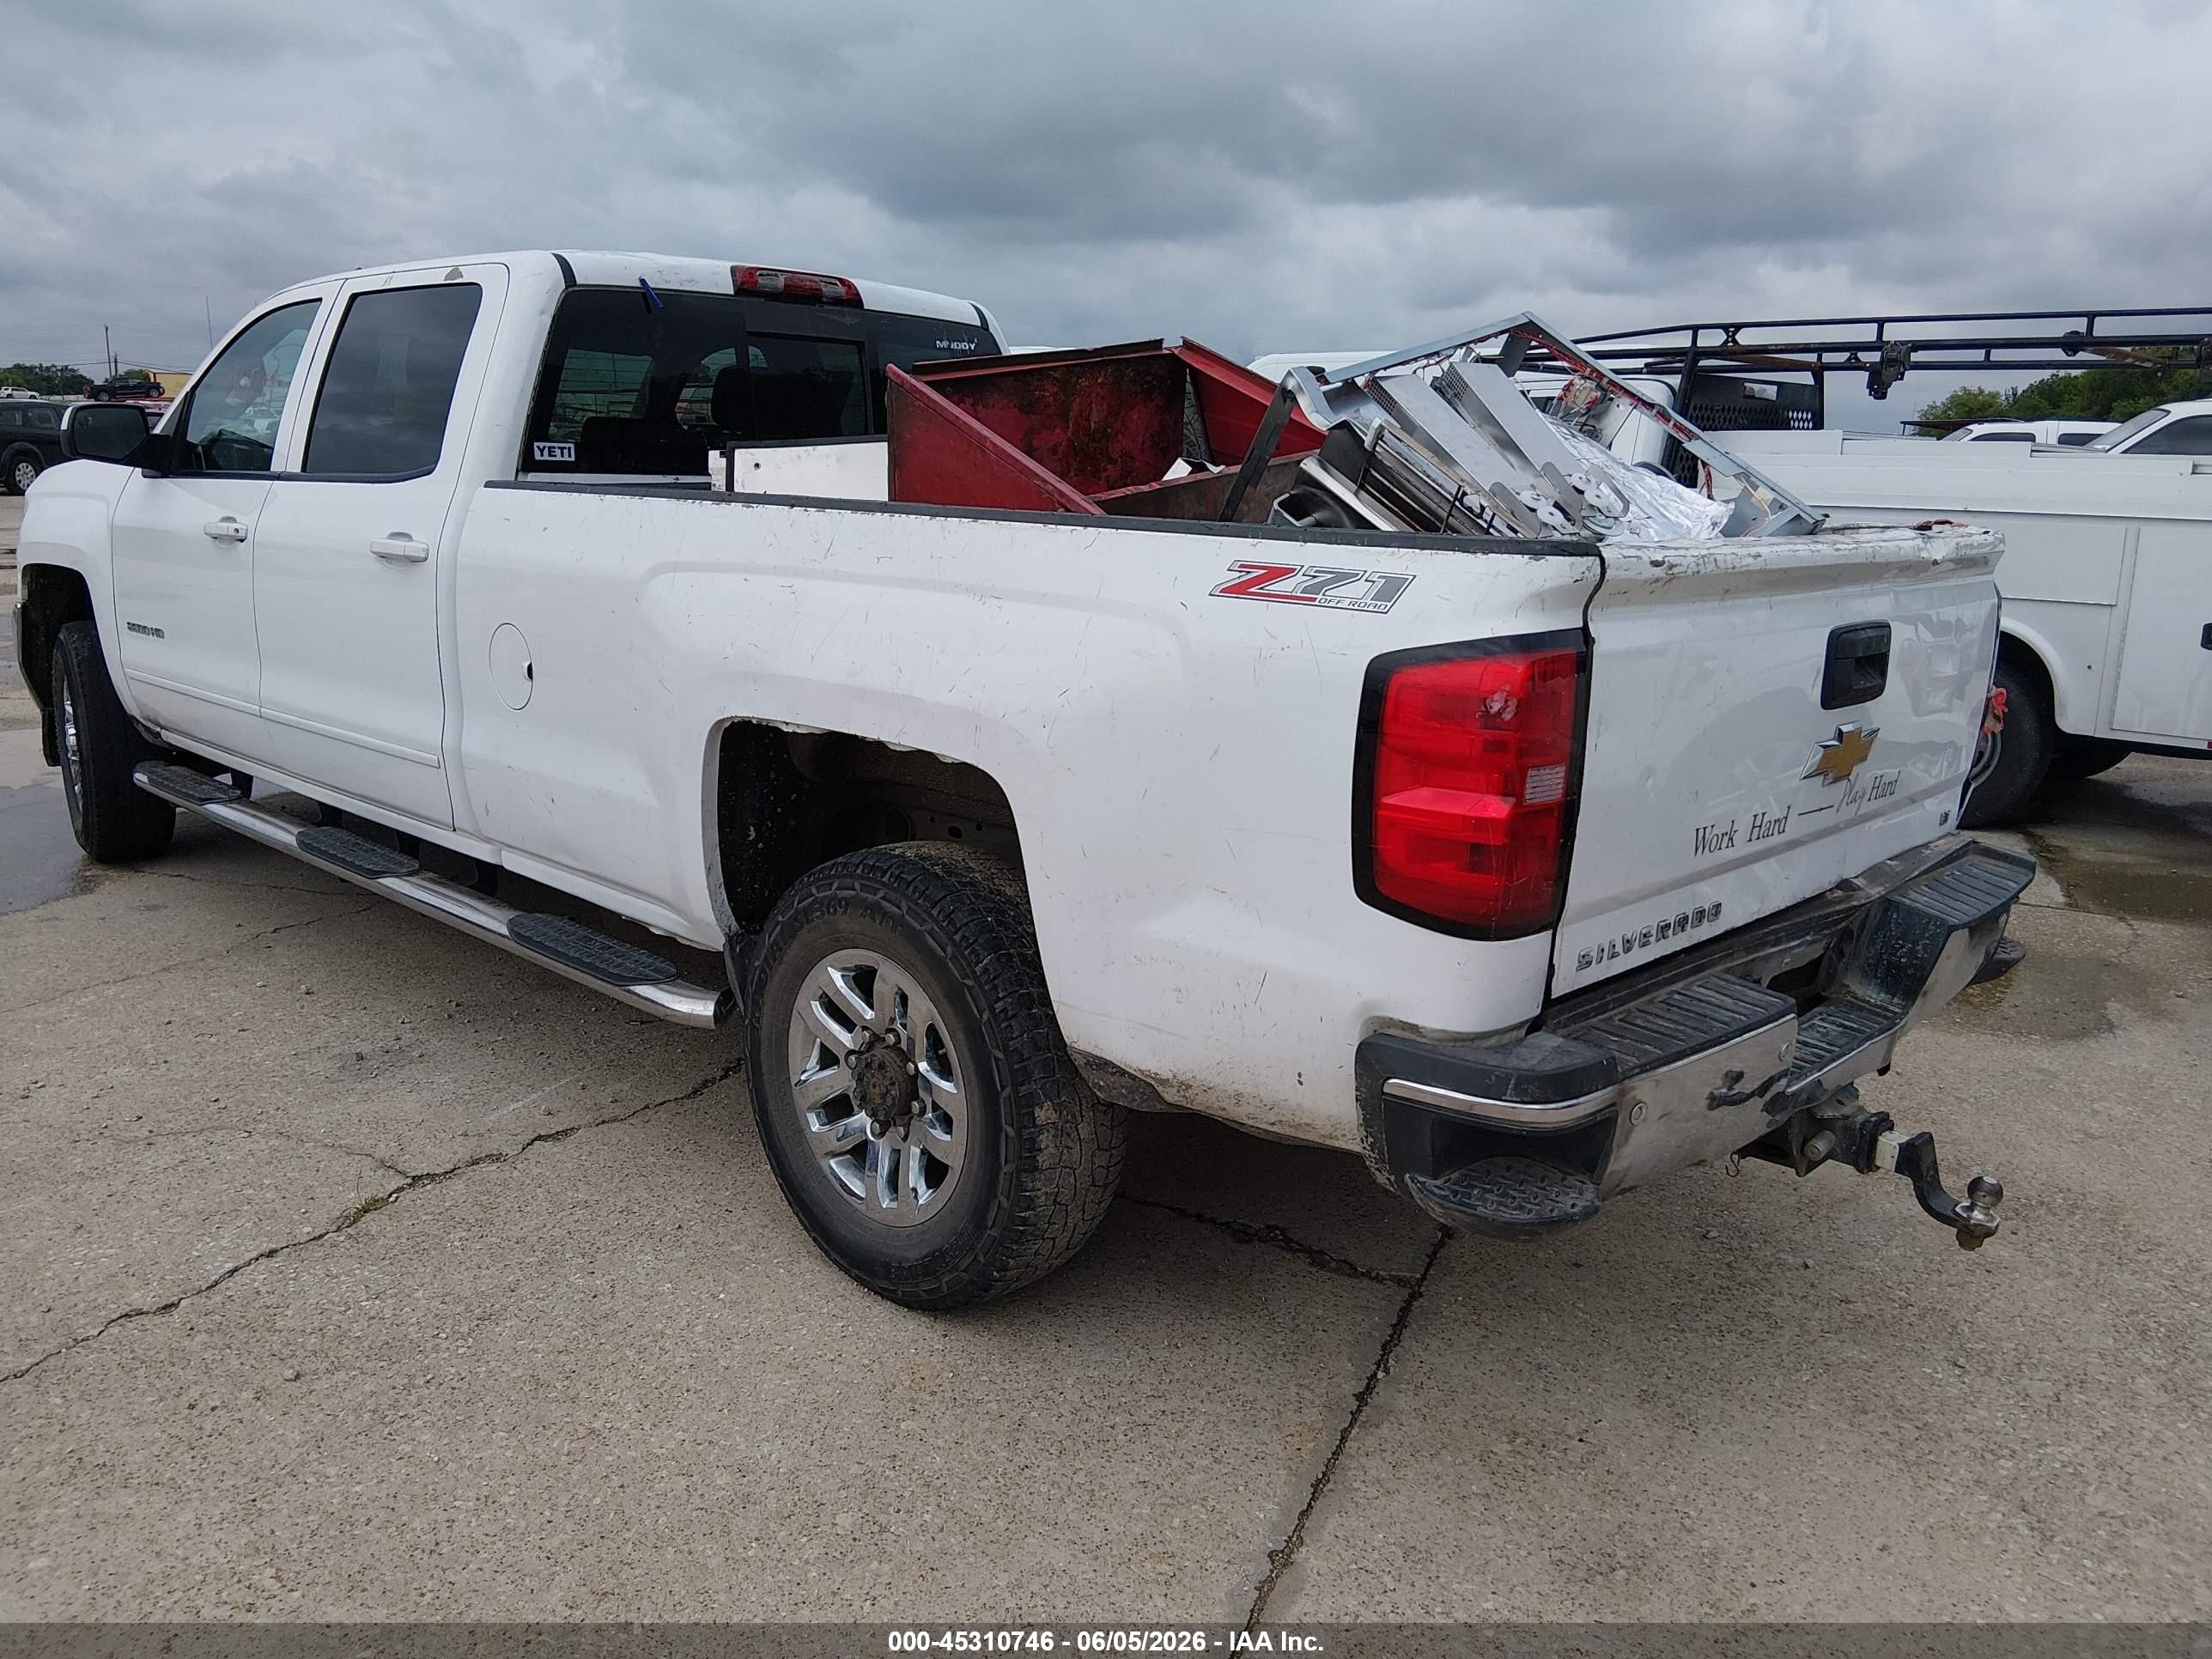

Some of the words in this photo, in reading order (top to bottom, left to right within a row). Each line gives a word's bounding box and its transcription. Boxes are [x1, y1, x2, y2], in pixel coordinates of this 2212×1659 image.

[535, 445, 572, 459] YETI
[1208, 560, 1417, 605] Z71
[1317, 597, 1347, 606] OFF
[1347, 600, 1389, 611] ROAD
[1694, 820, 1739, 857] Work
[1747, 805, 1791, 843] Hard
[1867, 769, 1901, 802] Hard
[1576, 901, 1723, 972] SILVERADO
